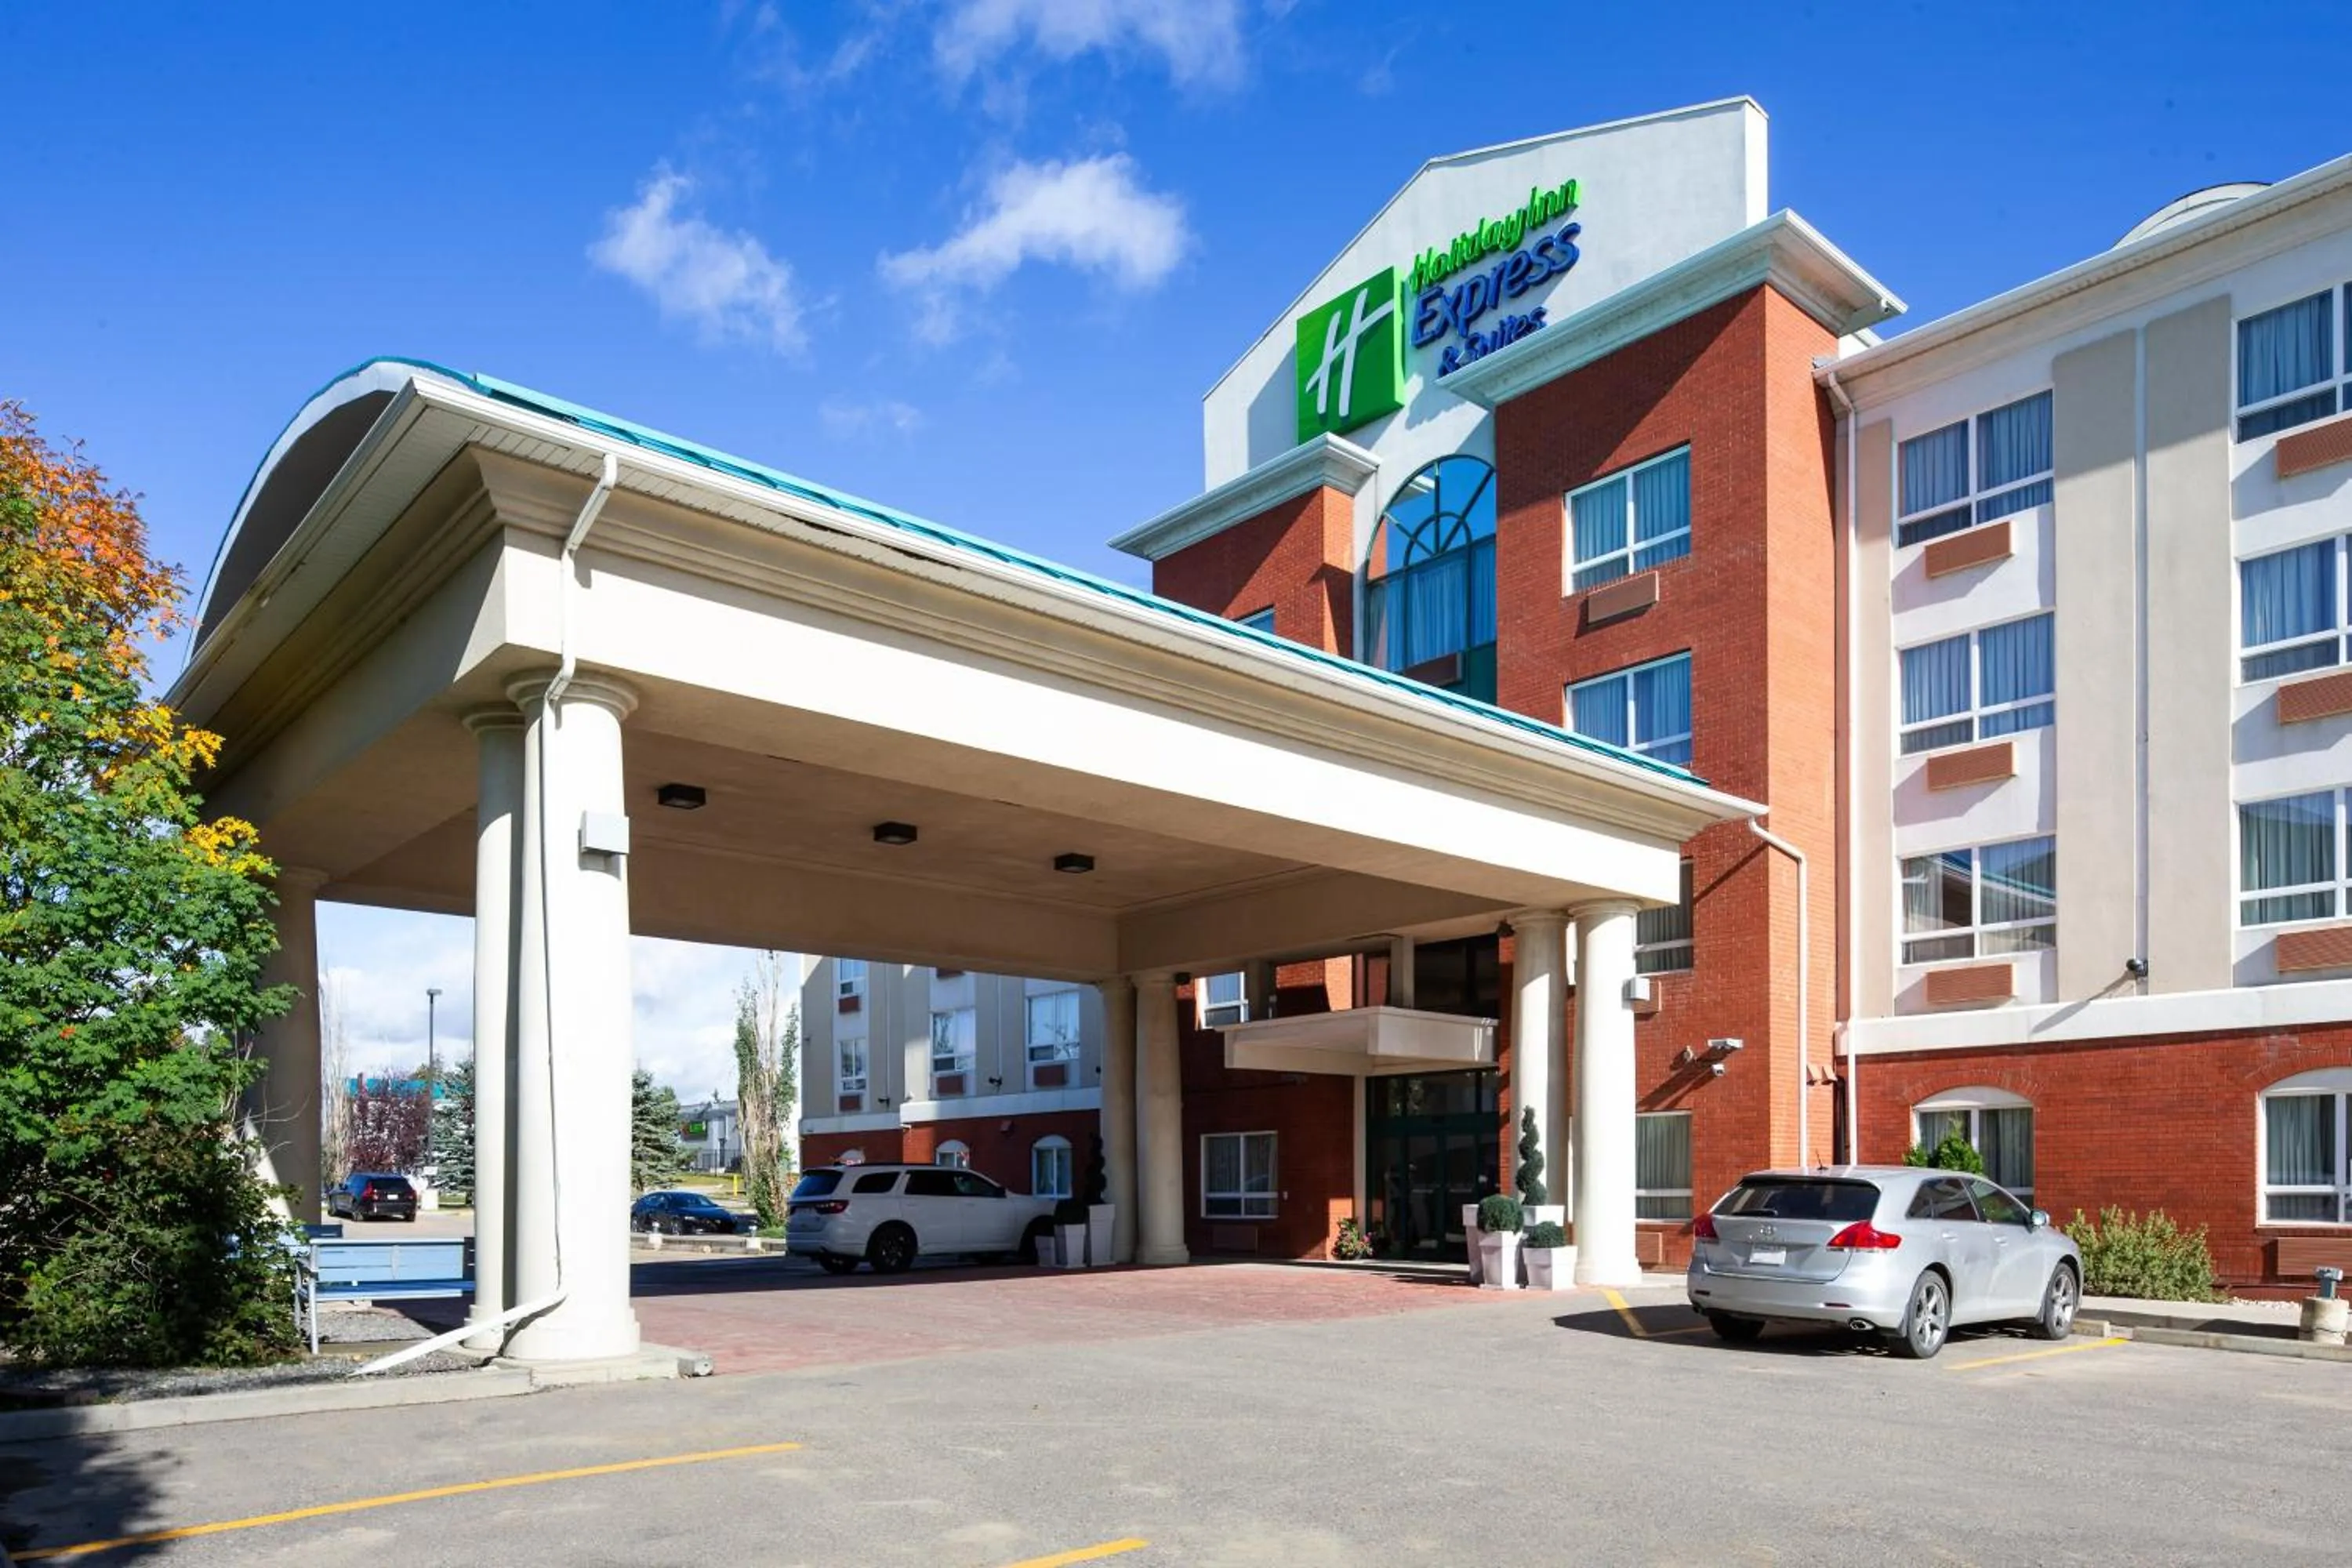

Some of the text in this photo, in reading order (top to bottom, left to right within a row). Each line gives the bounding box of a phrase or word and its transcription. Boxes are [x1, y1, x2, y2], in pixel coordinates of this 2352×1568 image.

[1410, 179, 1578, 294] Holiday Inn
[1412, 223, 1581, 347] Express
[1438, 307, 1547, 376] & Suites
